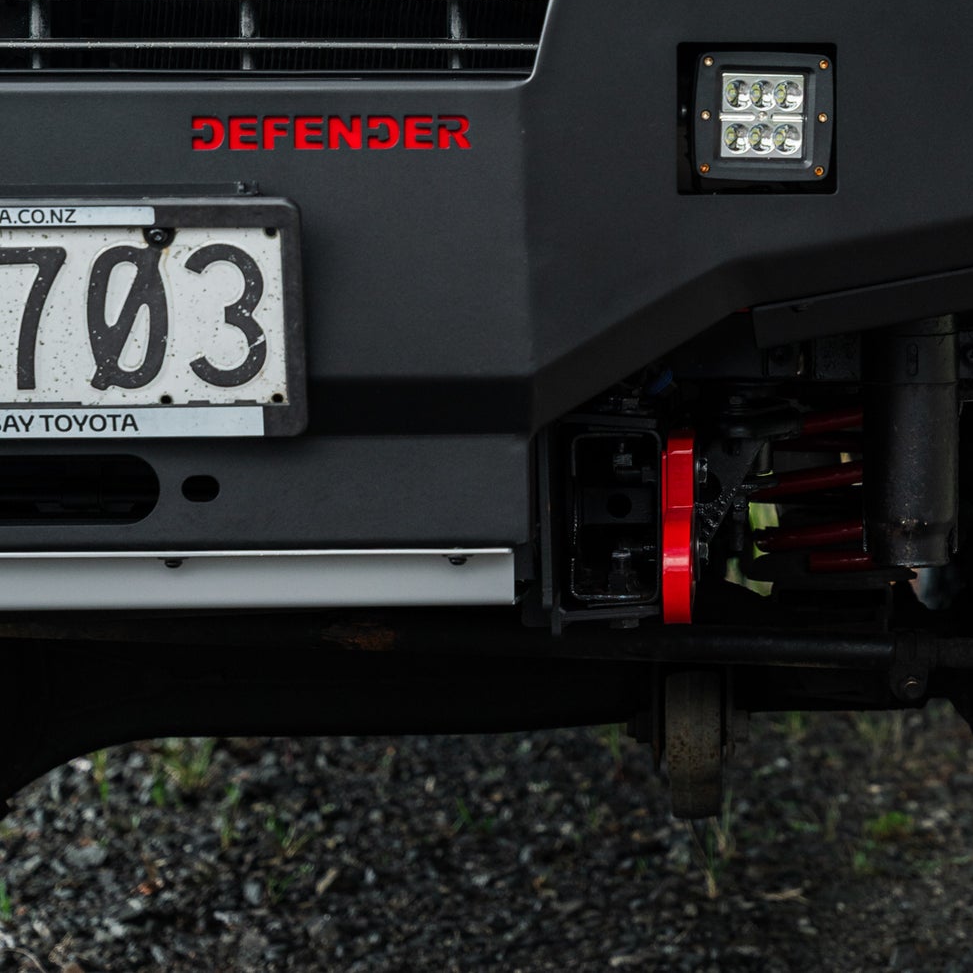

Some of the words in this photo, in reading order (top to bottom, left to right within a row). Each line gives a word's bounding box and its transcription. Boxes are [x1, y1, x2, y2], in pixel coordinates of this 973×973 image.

[191, 115, 472, 151] DEFENDER
[0, 414, 35, 433] AY
[39, 413, 140, 433] TOYOTA
